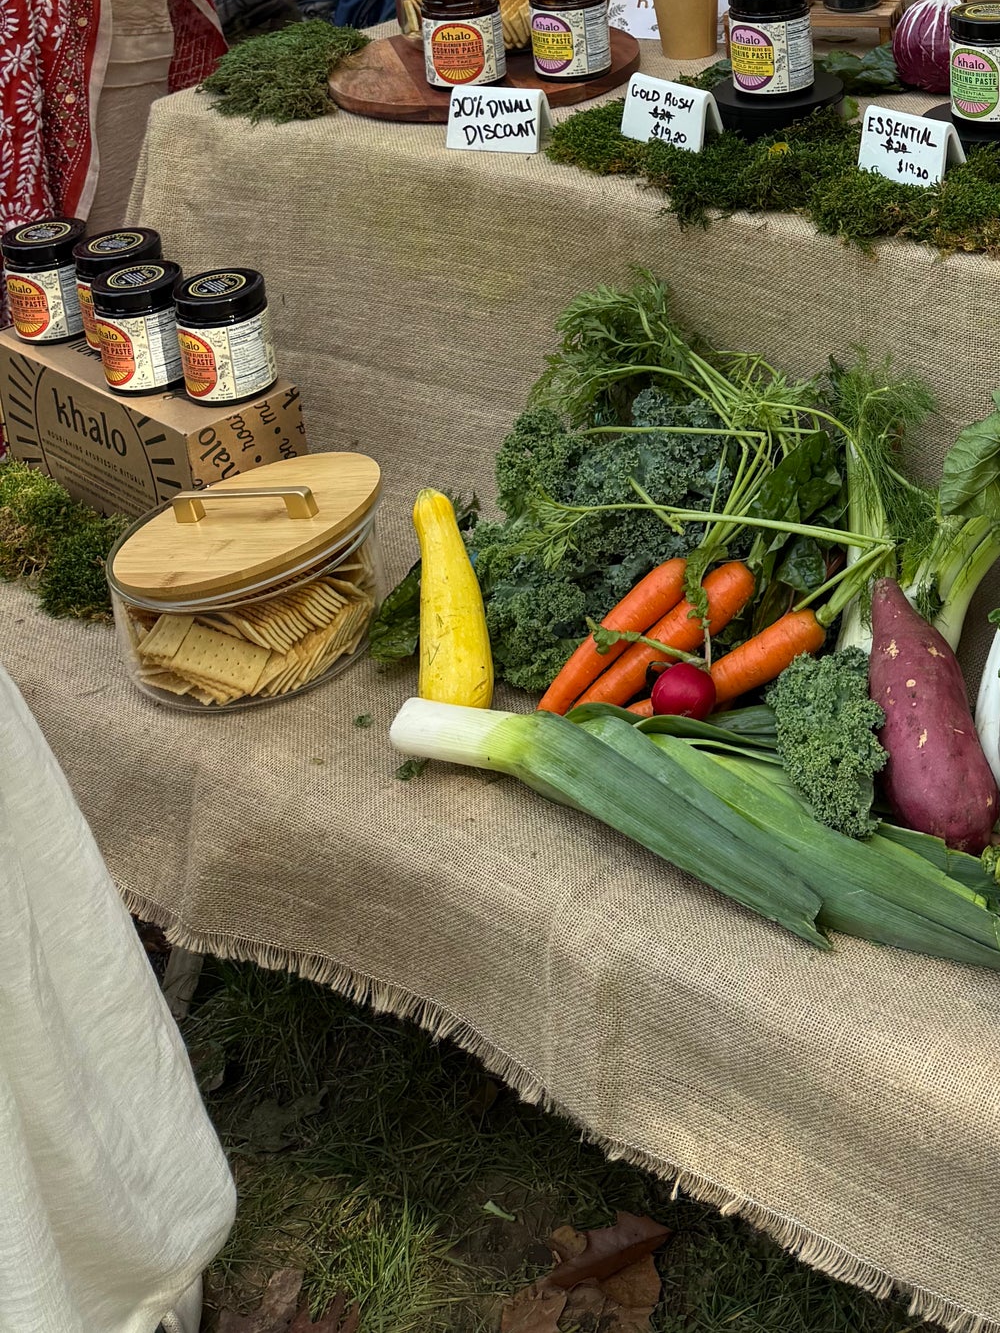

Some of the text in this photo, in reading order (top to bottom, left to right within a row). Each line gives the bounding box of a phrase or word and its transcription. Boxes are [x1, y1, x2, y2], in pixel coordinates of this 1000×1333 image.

[535, 20, 560, 32] khalo
[441, 32, 471, 41] khalo
[735, 32, 761, 45] khalo
[957, 56, 985, 71] khalo
[975, 78, 997, 86] PASTE
[631, 83, 694, 114] GOLD RUSH
[452, 96, 533, 119] 20% DIWALI
[462, 118, 537, 145] DISCOUNT
[867, 116, 937, 148] ESSENTIAL
[111, 347, 132, 355] PASTE
[192, 358, 214, 366] PASTE
[51, 387, 127, 457] khalo
